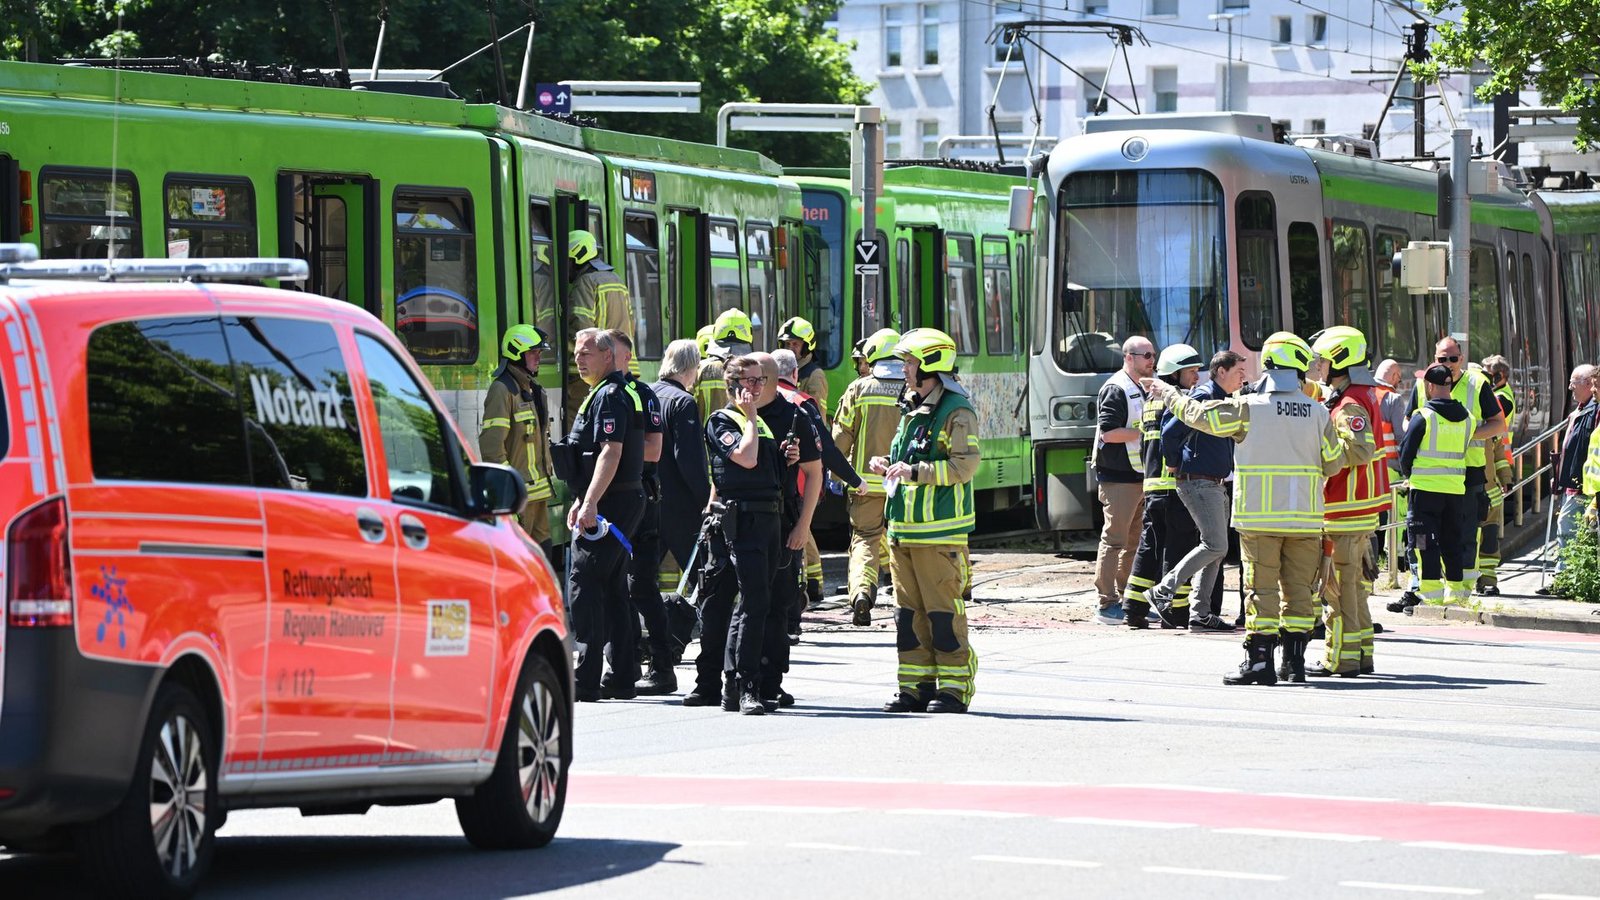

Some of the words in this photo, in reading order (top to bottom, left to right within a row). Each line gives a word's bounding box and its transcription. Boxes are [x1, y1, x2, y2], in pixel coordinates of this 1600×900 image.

[249, 373, 347, 429] Notarzt
[1276, 400, 1312, 418] B-DIENST
[283, 568, 374, 606] Rettungsdienst
[283, 608, 326, 645] Region
[330, 610, 385, 637] Hannover
[293, 668, 315, 696] 112
